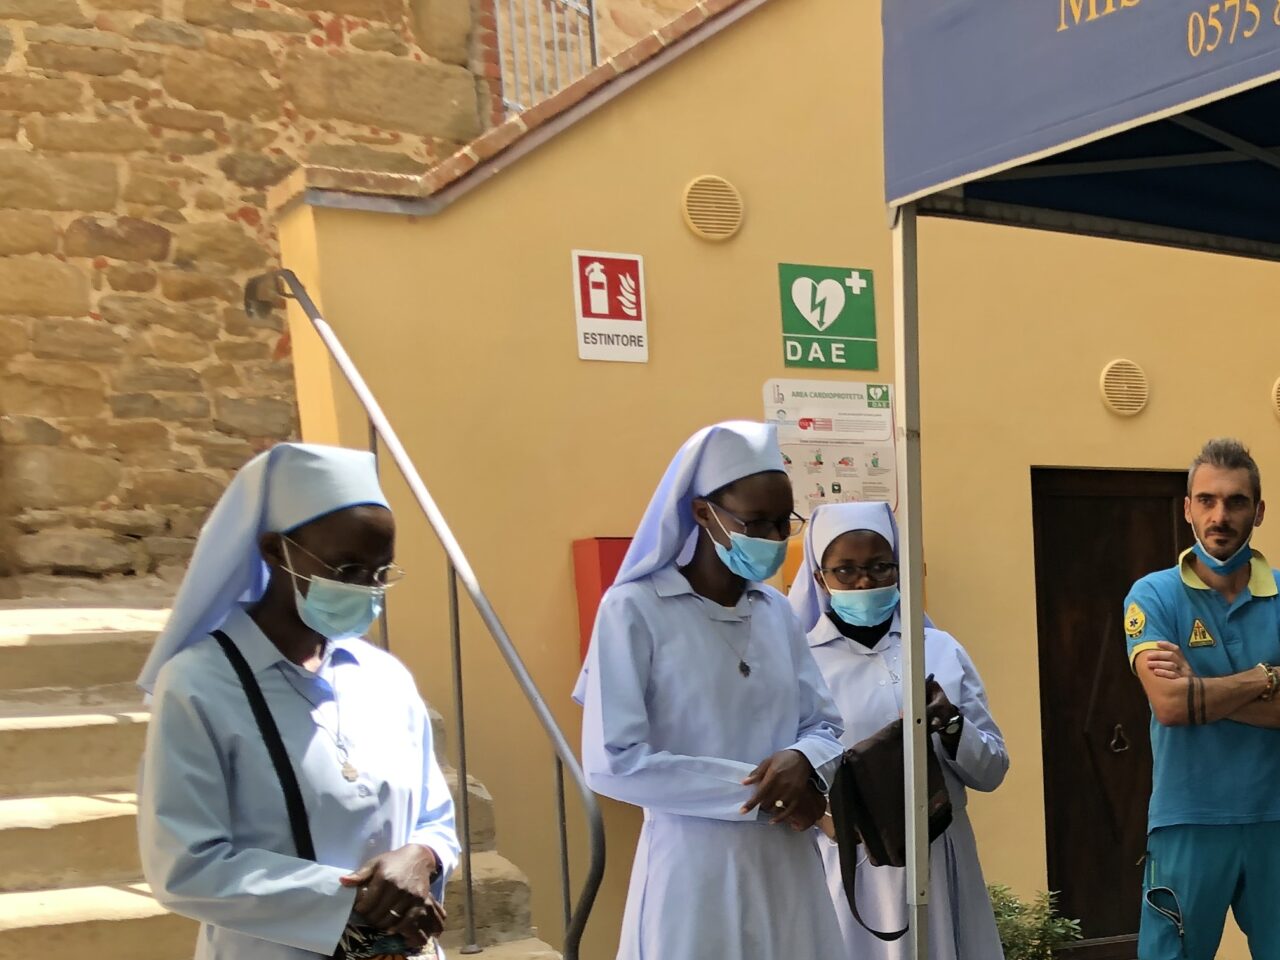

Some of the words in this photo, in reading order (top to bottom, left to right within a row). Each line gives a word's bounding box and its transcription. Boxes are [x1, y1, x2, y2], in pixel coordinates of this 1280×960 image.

[1187, 0, 1261, 57] 0575
[583, 332, 644, 348] ESTINTORE
[785, 340, 846, 364] DAE
[809, 391, 865, 400] CARDIOPROTETTA
